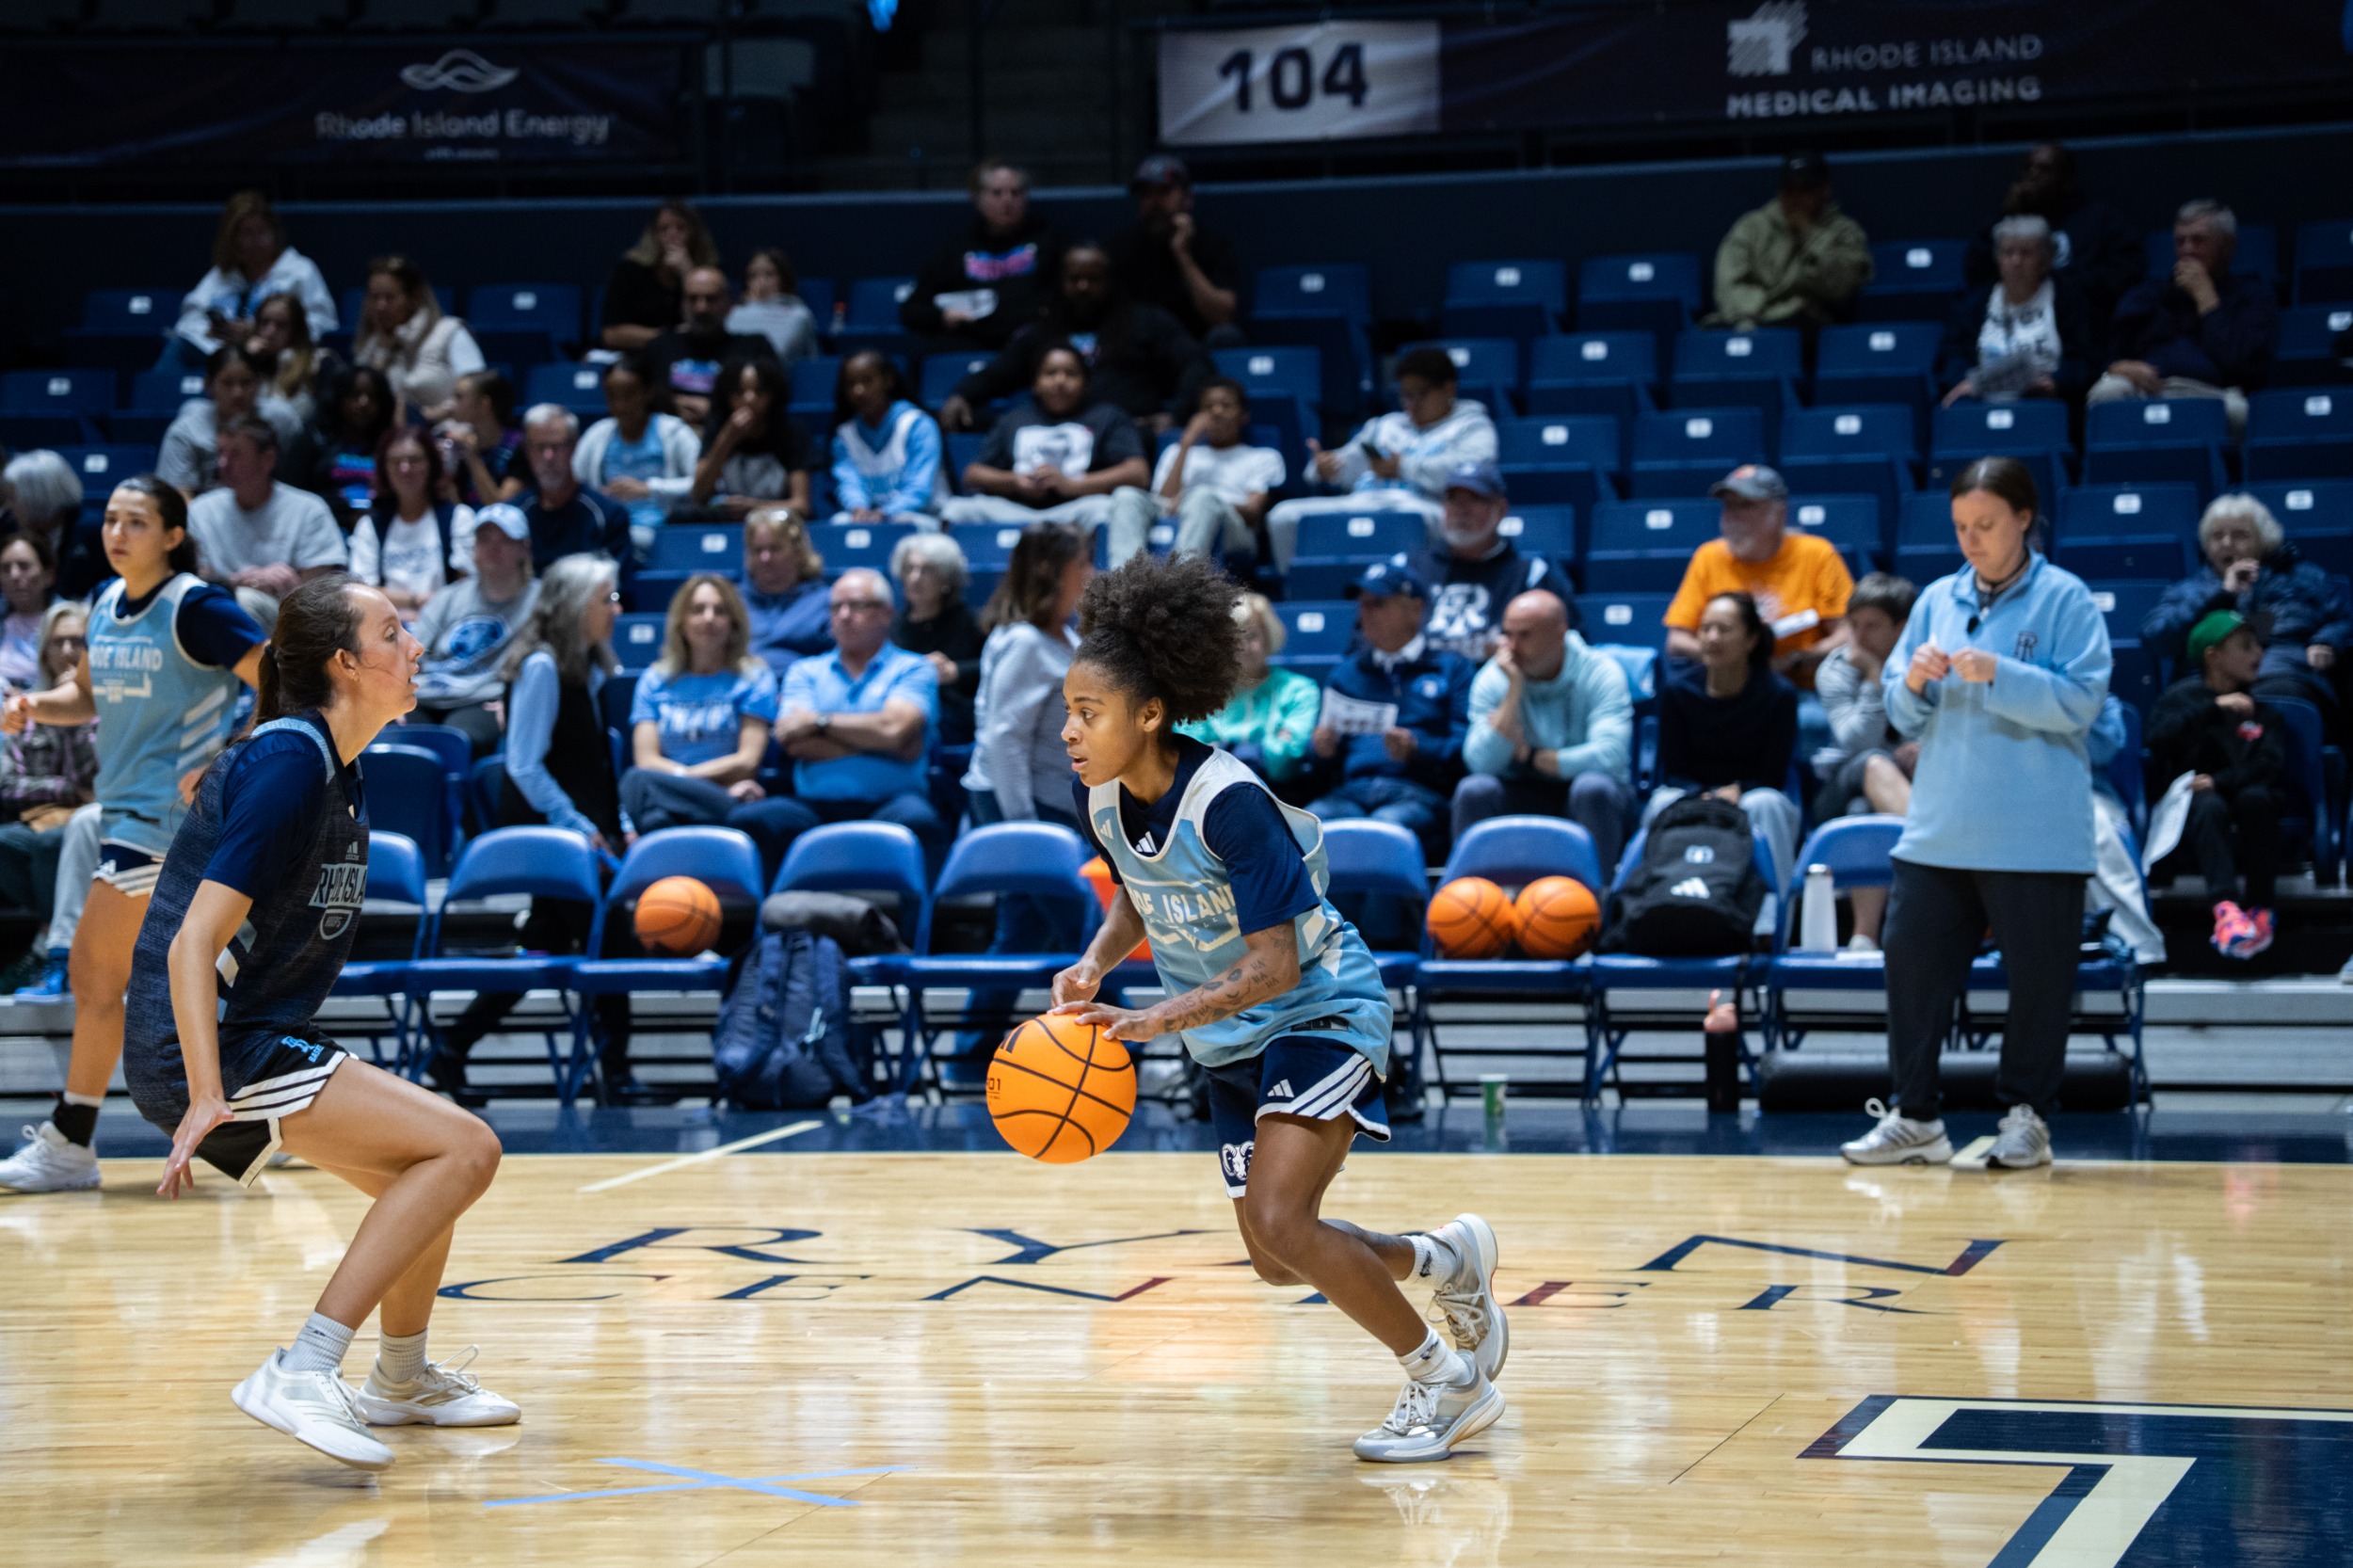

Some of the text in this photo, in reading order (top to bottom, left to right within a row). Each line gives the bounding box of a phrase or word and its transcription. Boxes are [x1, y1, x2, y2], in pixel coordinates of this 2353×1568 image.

[1811, 33, 2046, 72] RHODE ISLAND
[1220, 43, 1367, 111] 104
[1726, 75, 2042, 119] MEDICAL IMAGING
[315, 108, 610, 145] Rhode Island Energy
[437, 1272, 1962, 1316] CENER
